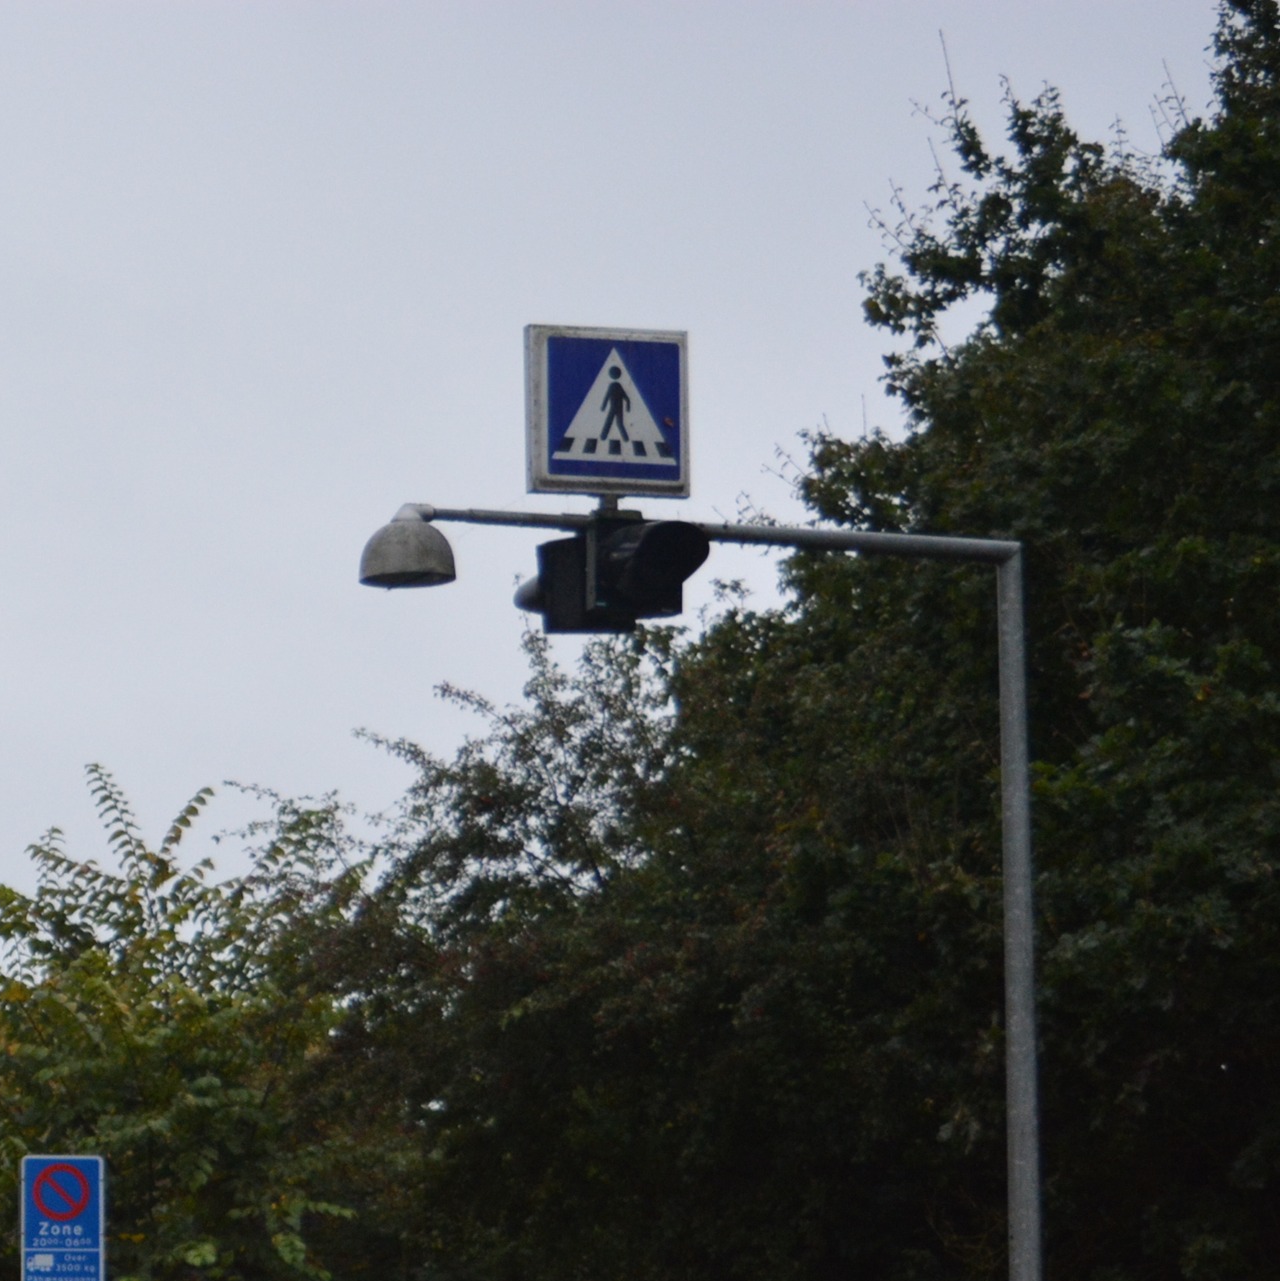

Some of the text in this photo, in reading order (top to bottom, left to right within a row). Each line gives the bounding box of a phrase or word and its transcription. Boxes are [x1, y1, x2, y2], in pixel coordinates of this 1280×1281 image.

[38, 1221, 83, 1236] Zone
[64, 1254, 87, 1262] Over
[56, 1263, 81, 1272] 3500
